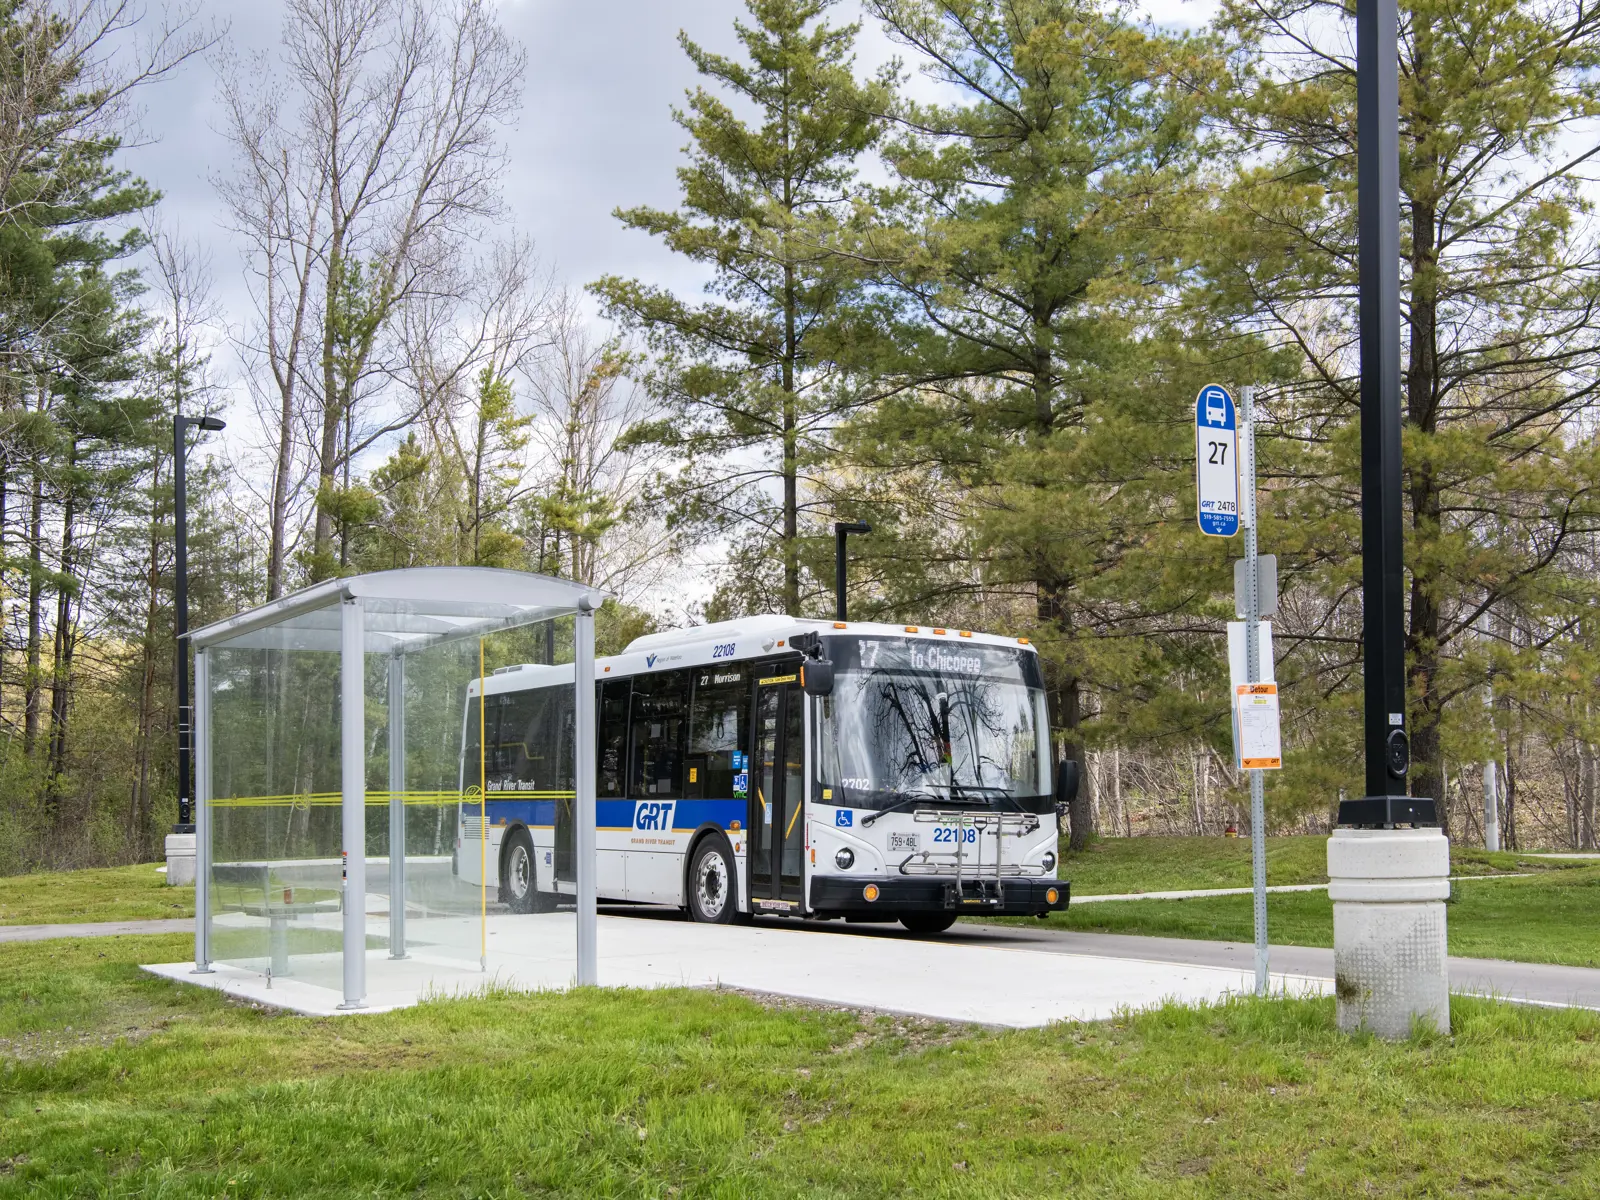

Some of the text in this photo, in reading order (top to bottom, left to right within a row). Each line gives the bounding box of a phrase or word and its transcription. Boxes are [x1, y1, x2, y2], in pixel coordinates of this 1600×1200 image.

[1208, 441, 1228, 466] 27
[1201, 500, 1236, 512] GRT 2478
[712, 643, 736, 658] 22108
[909, 645, 924, 669] to
[928, 646, 981, 673] Chicopee
[700, 672, 741, 686] 27 Morrison
[1250, 685, 1269, 693] Detour
[487, 778, 535, 791] Grand River Transit
[636, 802, 673, 831] GRT
[630, 837, 645, 845] GRAND
[657, 838, 676, 846] TRANSIT
[933, 827, 976, 844] 22108
